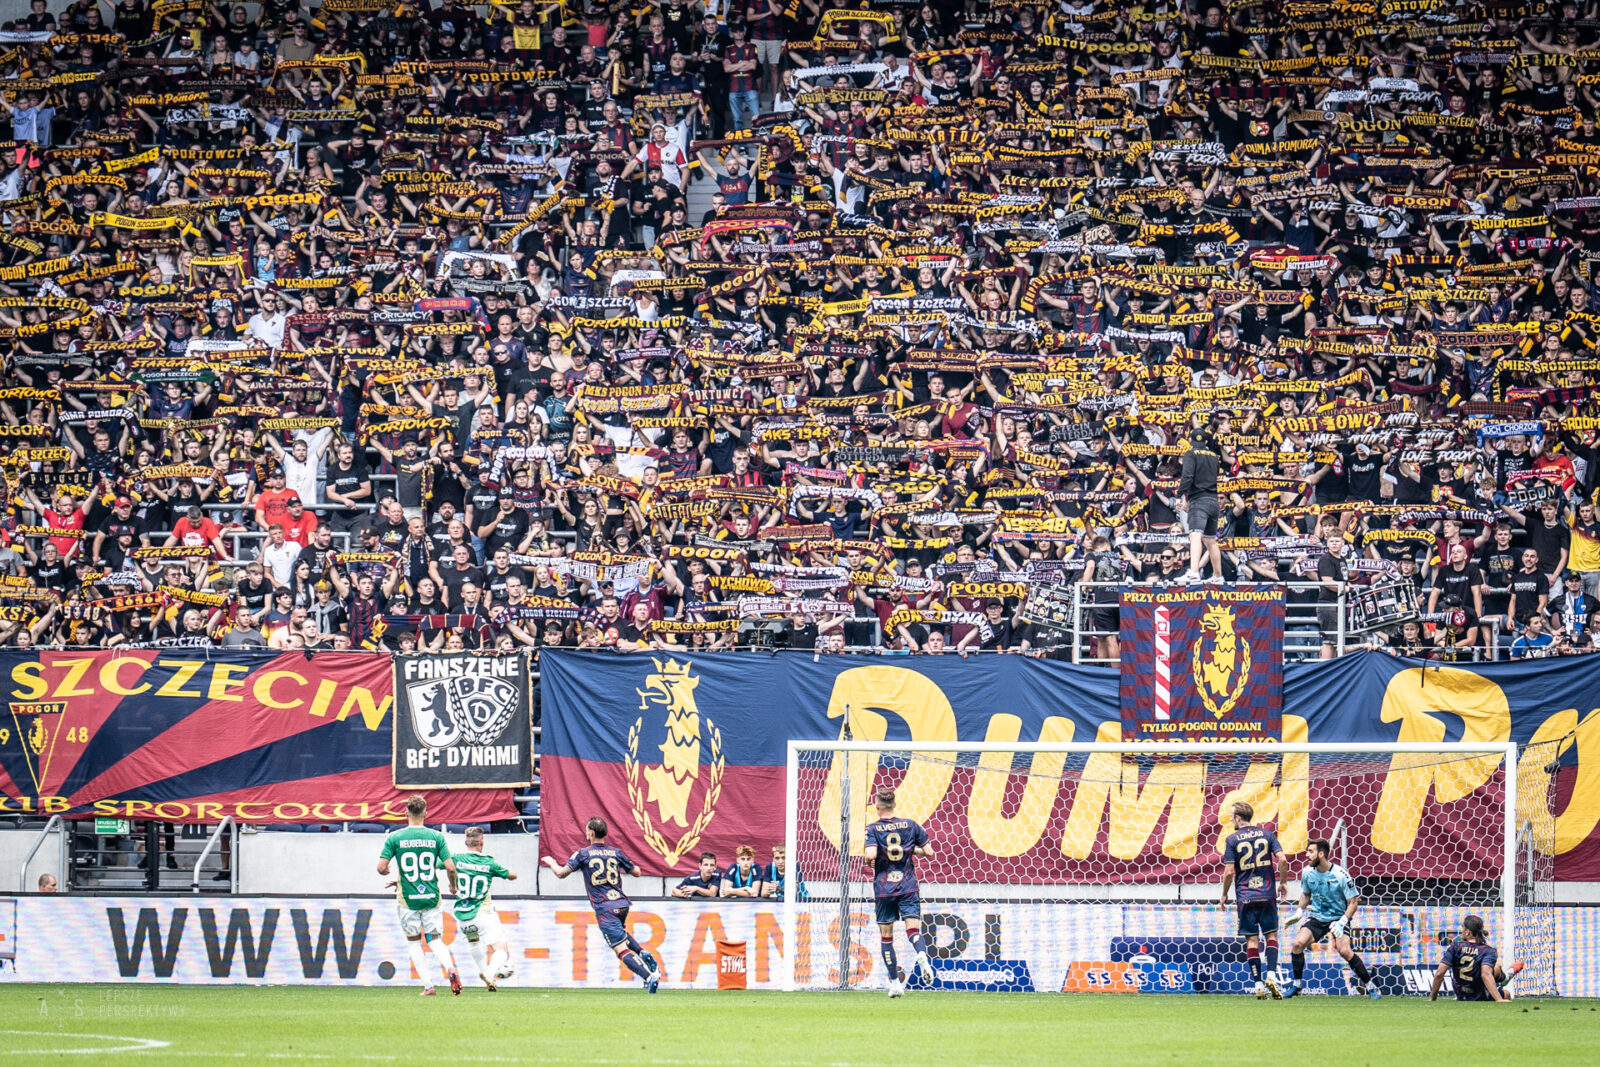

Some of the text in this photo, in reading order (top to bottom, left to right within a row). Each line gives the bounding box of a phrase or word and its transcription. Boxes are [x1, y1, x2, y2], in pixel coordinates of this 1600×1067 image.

[51, 34, 119, 45] MKS 1948
[1087, 42, 1152, 53] POGON
[1545, 55, 1577, 67] MKS
[469, 71, 557, 82] PORTOWCY
[1365, 94, 1392, 104] LOVE
[1340, 120, 1401, 132] POGON
[1246, 138, 1318, 154] DUMA POMORZA
[172, 148, 243, 160] PORTOWCY
[247, 193, 321, 207] POGON
[1393, 196, 1451, 206] POGON
[29, 222, 79, 233] POGON
[709, 219, 787, 230] POGON
[28, 256, 69, 276] SZCZECIN
[1286, 260, 1330, 270] ROTTERDAM
[712, 266, 767, 293] POGON
[1102, 276, 1172, 295] STARGARD
[1162, 275, 1250, 292] AVE MKS
[118, 284, 177, 296] POGON
[912, 297, 963, 310] SZCZECIN
[373, 311, 429, 322] PORTOWCY
[867, 315, 900, 325] POGON
[1169, 312, 1214, 325] SZCZECIN
[18, 316, 90, 337] MKS 1948
[413, 324, 473, 334] POGON
[1438, 333, 1518, 344] PORTOWCY
[82, 340, 156, 351] STARGARD
[210, 350, 269, 361] FC BERLIN
[357, 361, 418, 371] POGON
[584, 385, 642, 396] MKS POGON
[688, 389, 747, 401] PORTOWCY
[805, 396, 877, 407] STARGARD
[59, 409, 134, 422] DUMA POMORZA
[367, 418, 450, 435] PORTOWCY
[1482, 424, 1502, 433] RUCH
[762, 426, 831, 441] MKS 1948
[1016, 450, 1060, 469] POGON
[1400, 451, 1430, 462] LOVE
[659, 475, 721, 490] POGON
[1508, 486, 1557, 503] POGON
[1275, 505, 1309, 516] POGON
[1276, 537, 1299, 546] BFC
[131, 547, 210, 559] STARGARD
[574, 552, 649, 563] POGON SZCZECIN
[669, 546, 739, 559] POGON
[950, 583, 1027, 598] POGON
[1124, 590, 1283, 602] PRZY GRANICY WYCHOWANI
[545, 609, 579, 619] SZCZECIN
[405, 657, 519, 679] FANSZENE
[11, 657, 392, 731] SZCZECIN
[460, 677, 513, 705] BFC
[1142, 722, 1261, 732] TYLKO POGONI ODDANI
[66, 727, 88, 743] 48
[406, 744, 520, 769] BFC DYNAMO
[876, 821, 908, 832] ULVESTAD
[399, 839, 436, 848] NEUGEBAUER
[886, 833, 903, 861] 8
[1237, 839, 1271, 870] 22
[401, 852, 436, 882] 99
[589, 858, 618, 886] 28
[457, 873, 488, 899] 90
[720, 956, 747, 972] STIHL
[1460, 956, 1475, 981] 2
[1087, 968, 1111, 986] STS
[1160, 970, 1183, 988] STS
